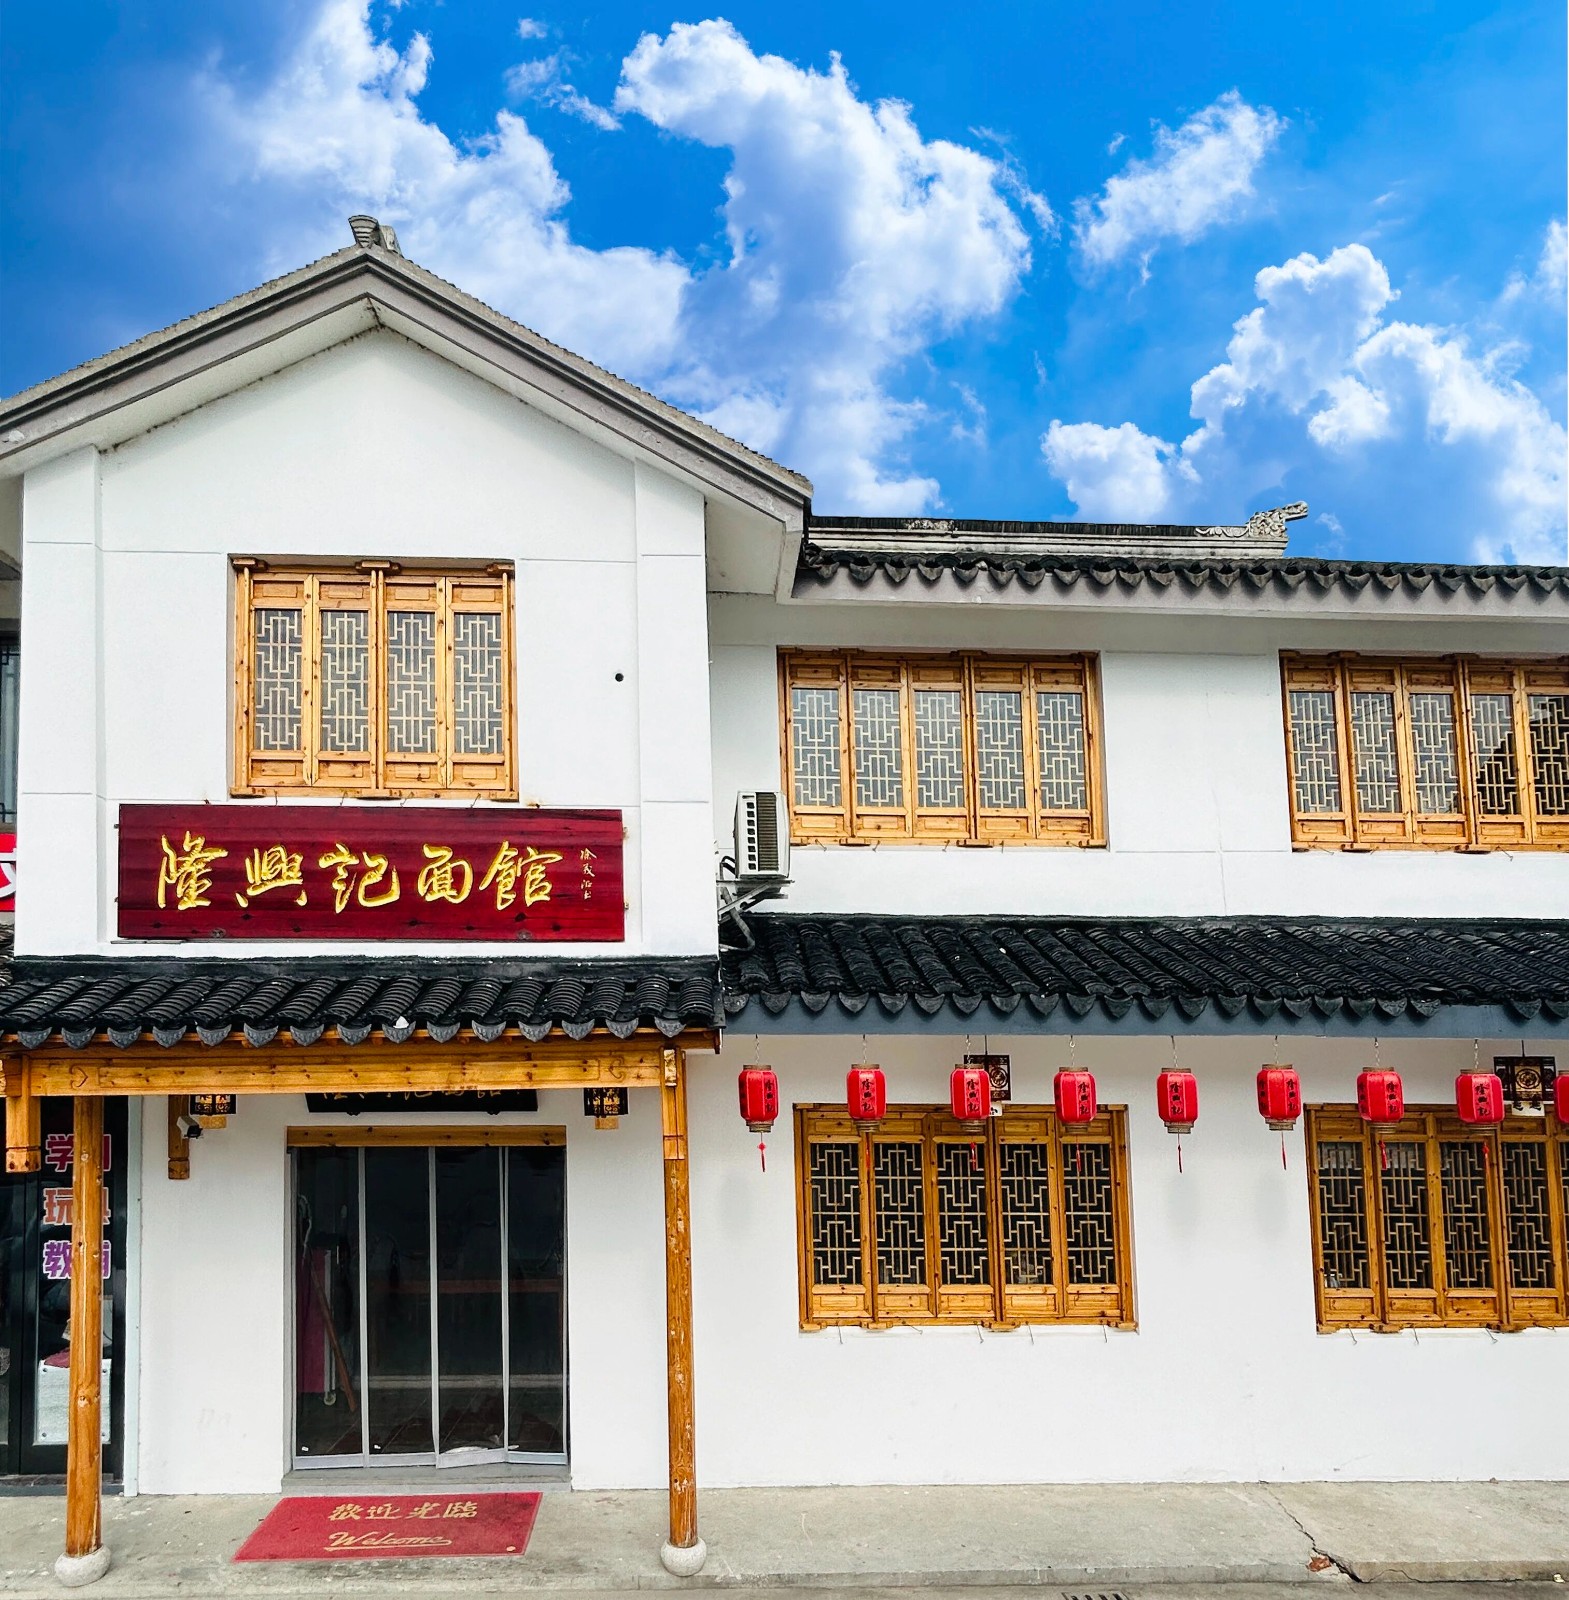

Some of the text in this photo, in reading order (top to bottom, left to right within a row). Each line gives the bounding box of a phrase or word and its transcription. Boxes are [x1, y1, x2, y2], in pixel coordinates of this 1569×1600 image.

[45, 1134, 111, 1172] 学
[43, 1187, 111, 1225] 玩
[323, 1531, 453, 1551] Welcome
